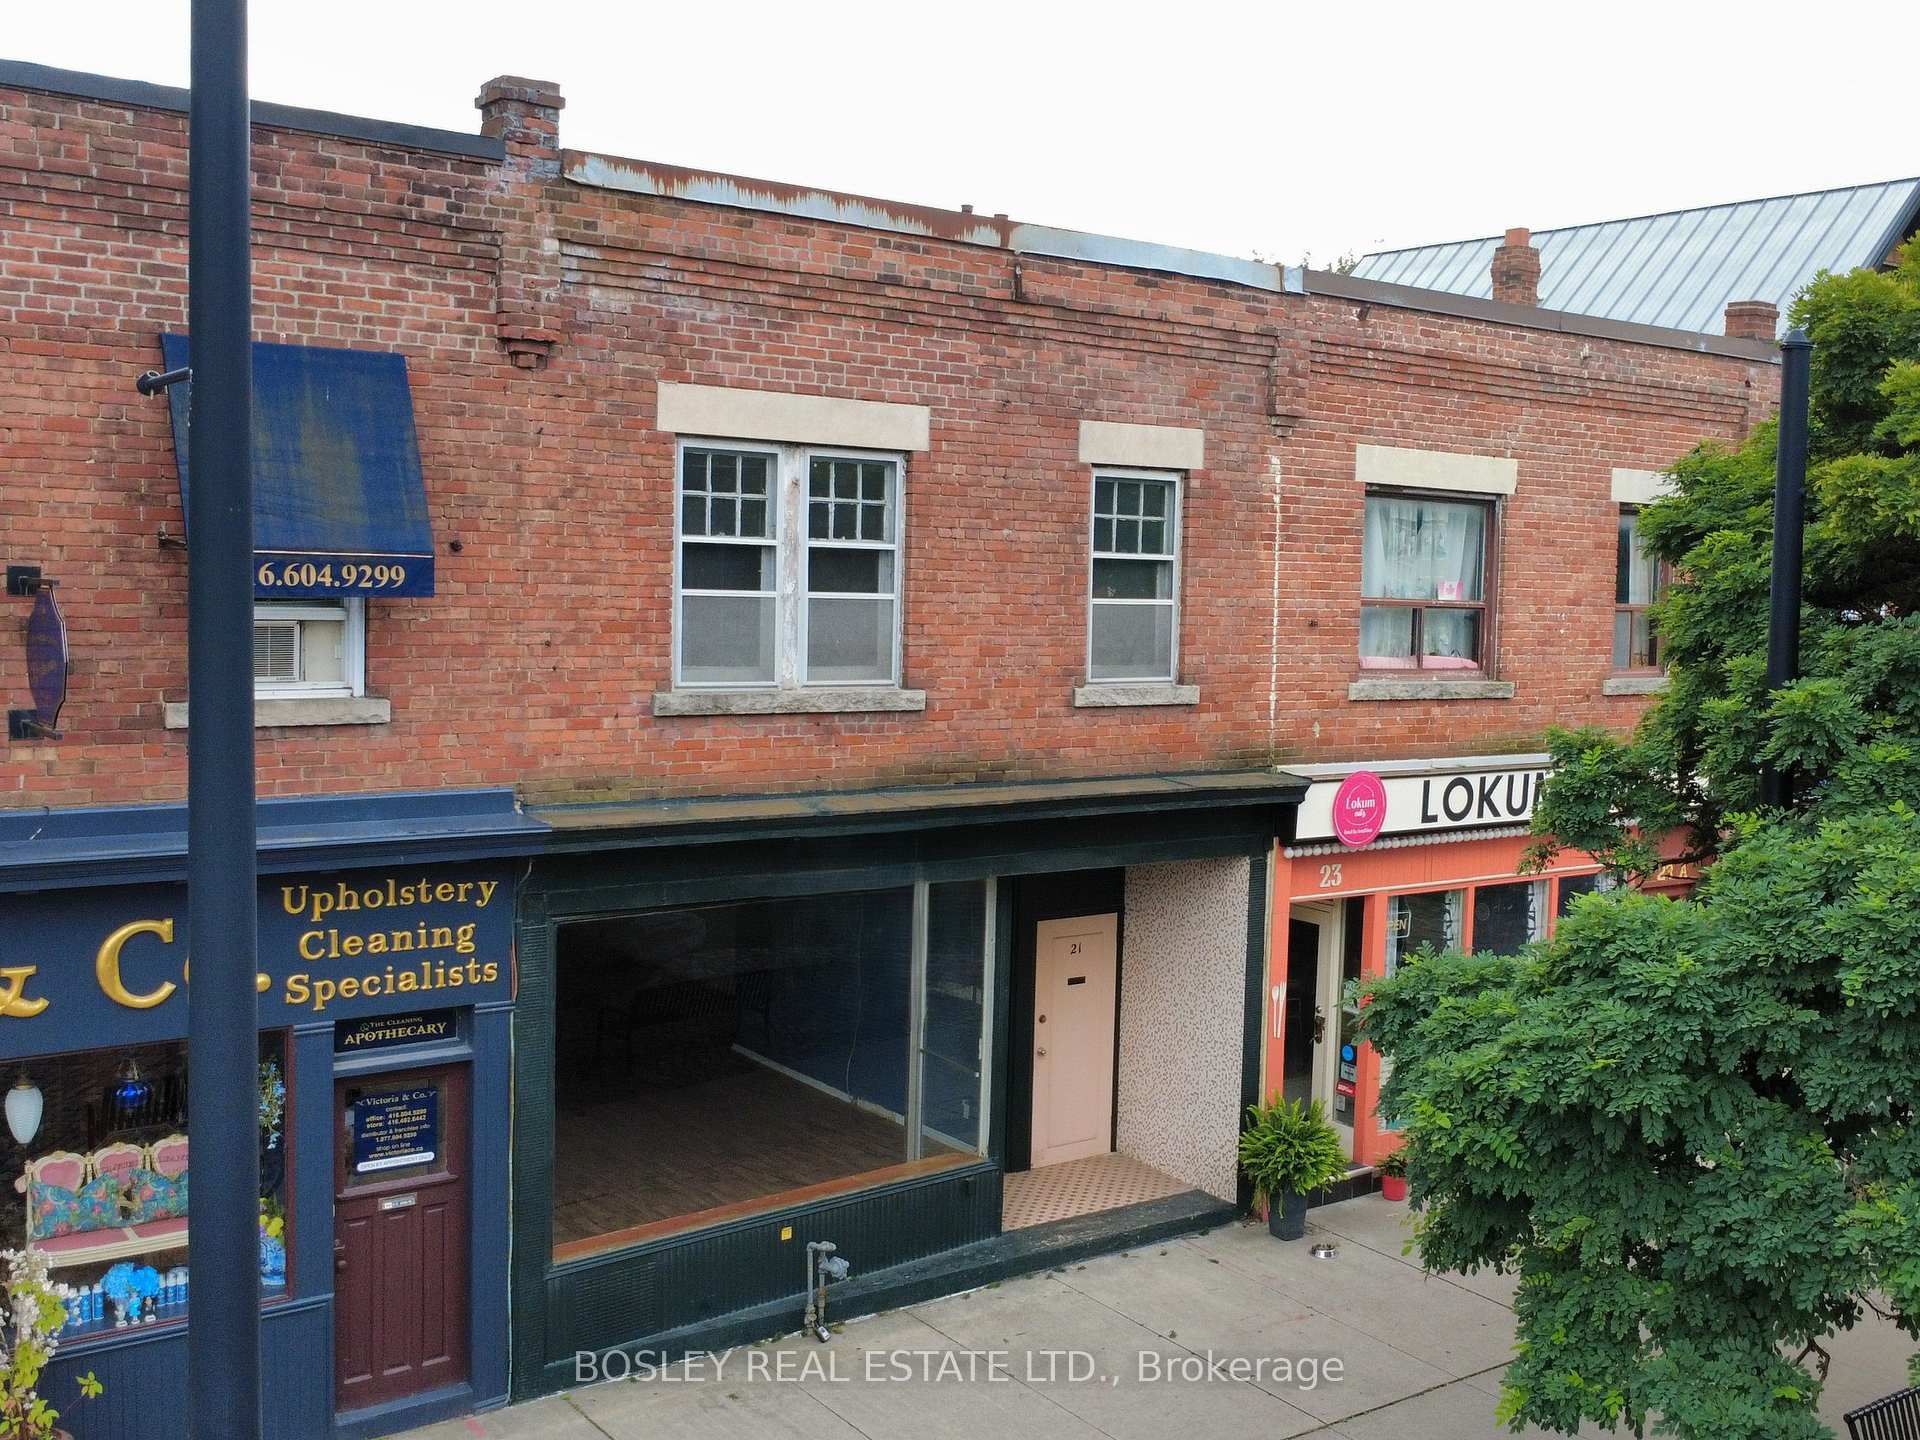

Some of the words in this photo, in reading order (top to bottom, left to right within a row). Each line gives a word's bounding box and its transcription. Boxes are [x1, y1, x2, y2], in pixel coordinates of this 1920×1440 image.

[255, 562, 406, 589] 6.604.9299
[1345, 797, 1375, 810] Lokum
[1319, 863, 1342, 888] 23
[281, 878, 499, 922] Upholstery
[299, 921, 477, 960] Cleaning
[1070, 942, 1082, 955] 21
[96, 917, 272, 1009] C.
[285, 957, 498, 1011] Specialists
[343, 1022, 447, 1045] APOTHECARY
[386, 1016, 423, 1026] CLEANING
[366, 1095, 399, 1106] Victoria
[412, 1091, 428, 1100] Co.
